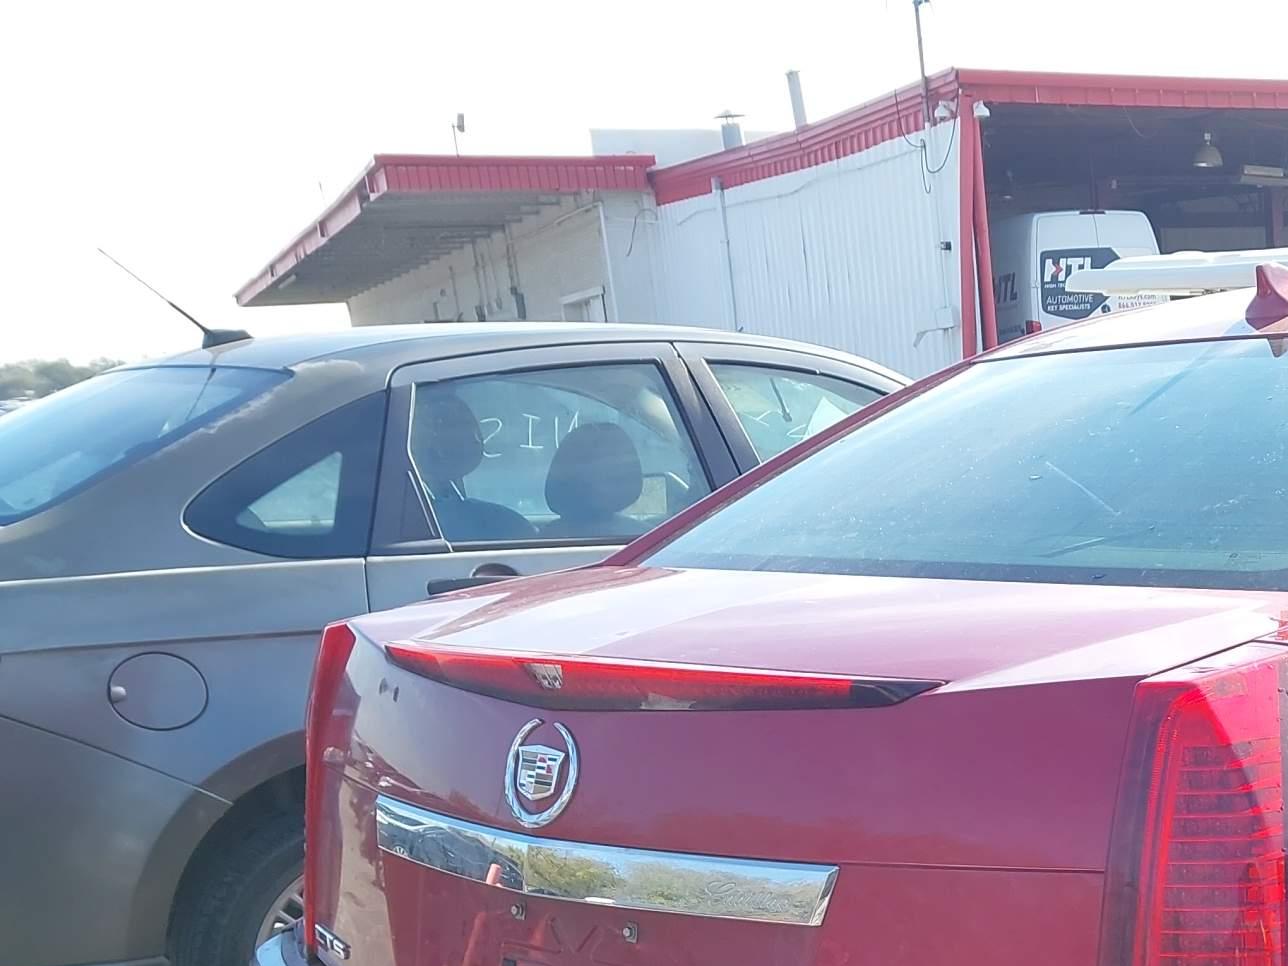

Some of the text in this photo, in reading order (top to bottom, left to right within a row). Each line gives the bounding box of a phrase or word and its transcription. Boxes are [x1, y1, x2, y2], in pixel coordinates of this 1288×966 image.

[1046, 294, 1094, 304] AUTOMOTIVE
[1059, 303, 1091, 311] SPECIALISTS
[704, 880, 792, 913] Cadillac
[315, 923, 351, 960] CTS
